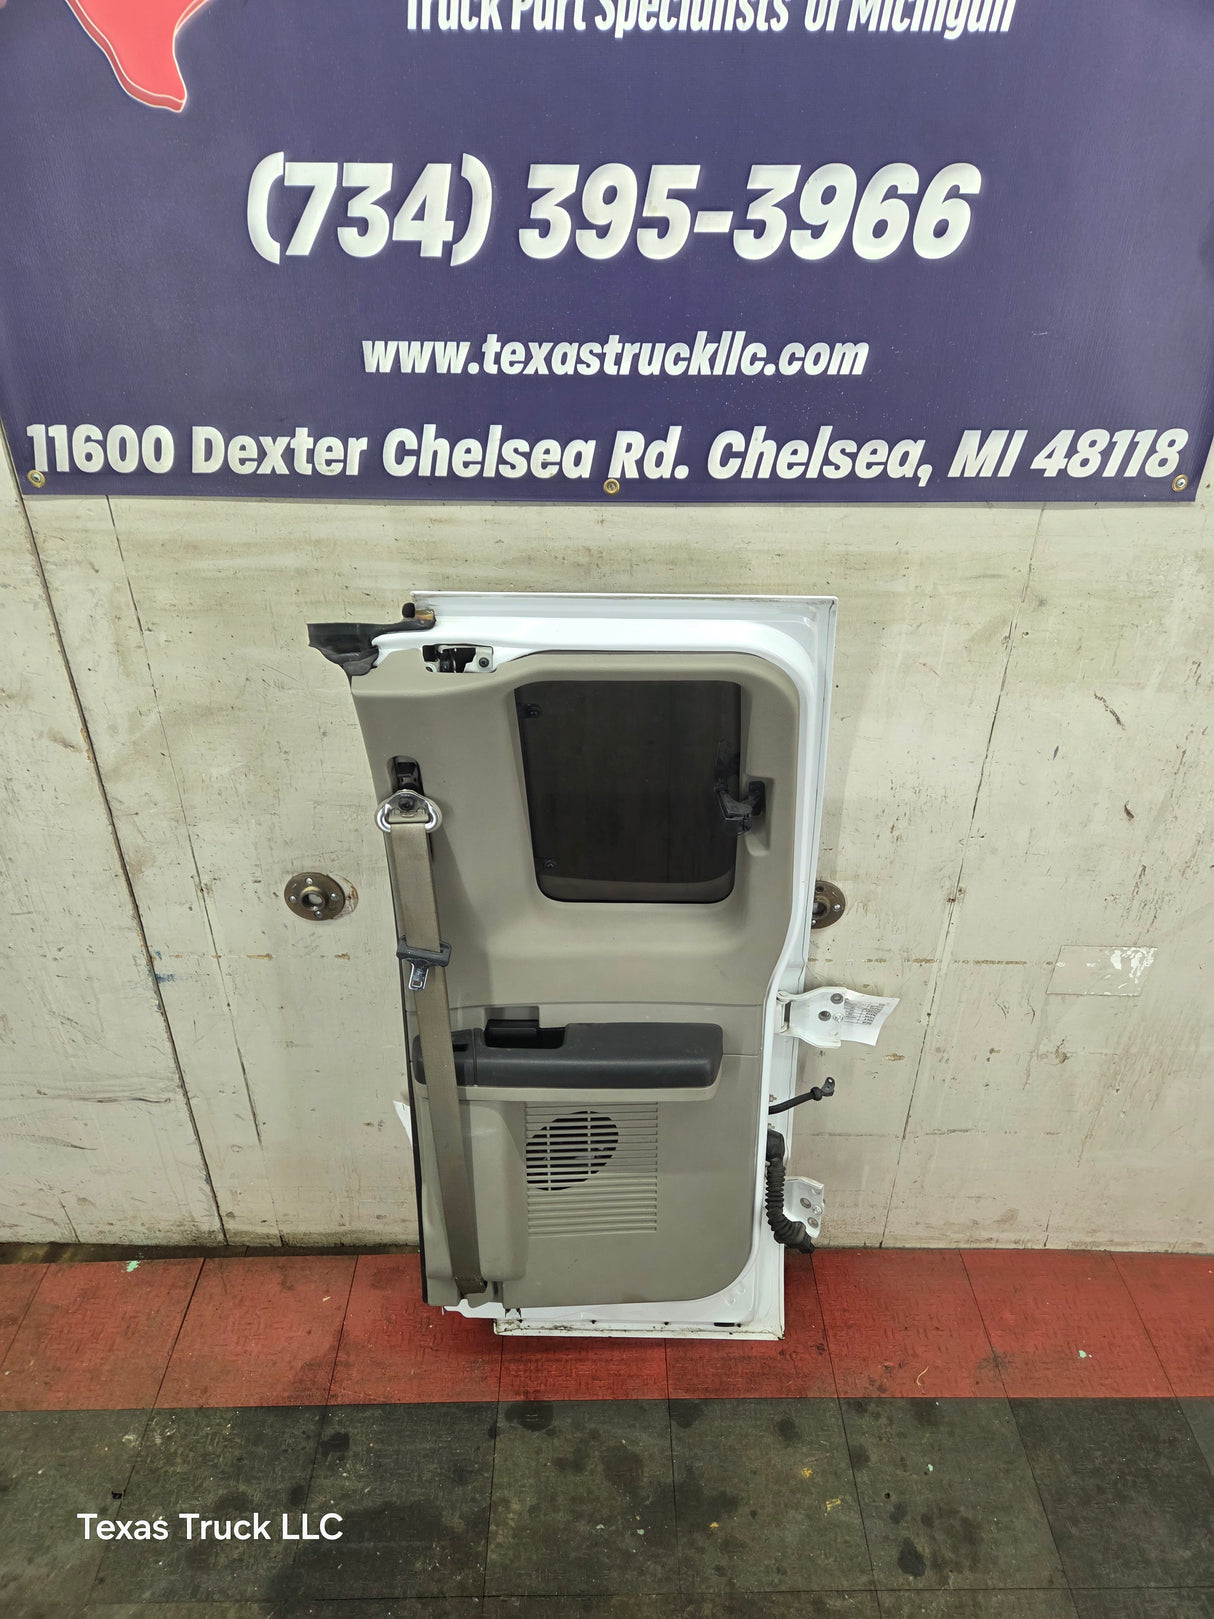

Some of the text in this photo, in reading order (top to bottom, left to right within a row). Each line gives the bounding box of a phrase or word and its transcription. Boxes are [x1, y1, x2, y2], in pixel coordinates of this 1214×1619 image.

[246, 151, 982, 267] (734) 395-3966
[361, 330, 870, 377] www.texastruckllc.com
[26, 423, 1190, 488] 11600 Dexter Chelsea Rd. Chelsea, MI 48118
